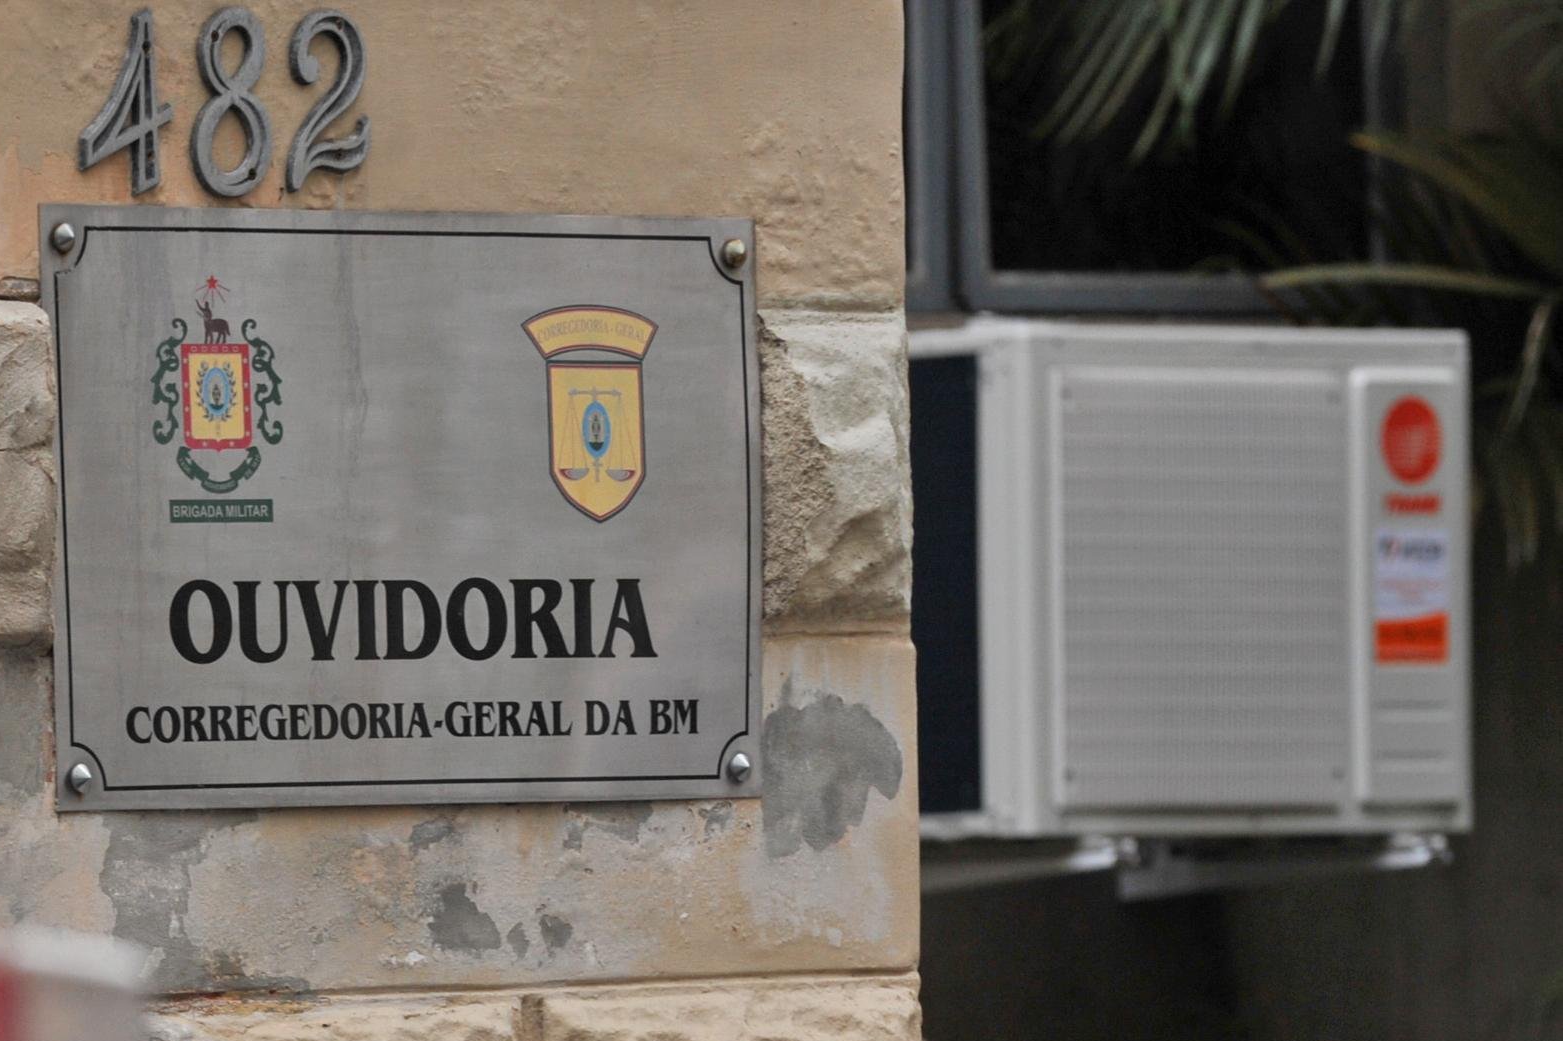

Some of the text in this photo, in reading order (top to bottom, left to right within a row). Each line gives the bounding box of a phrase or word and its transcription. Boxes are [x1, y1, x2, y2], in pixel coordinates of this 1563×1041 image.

[78, 6, 371, 197] 482
[172, 505, 269, 518] BRIGADA MILITAR
[169, 577, 658, 664] OUVIDORIA
[126, 699, 699, 743] CORREGEDORIA-GERAL DA BM
